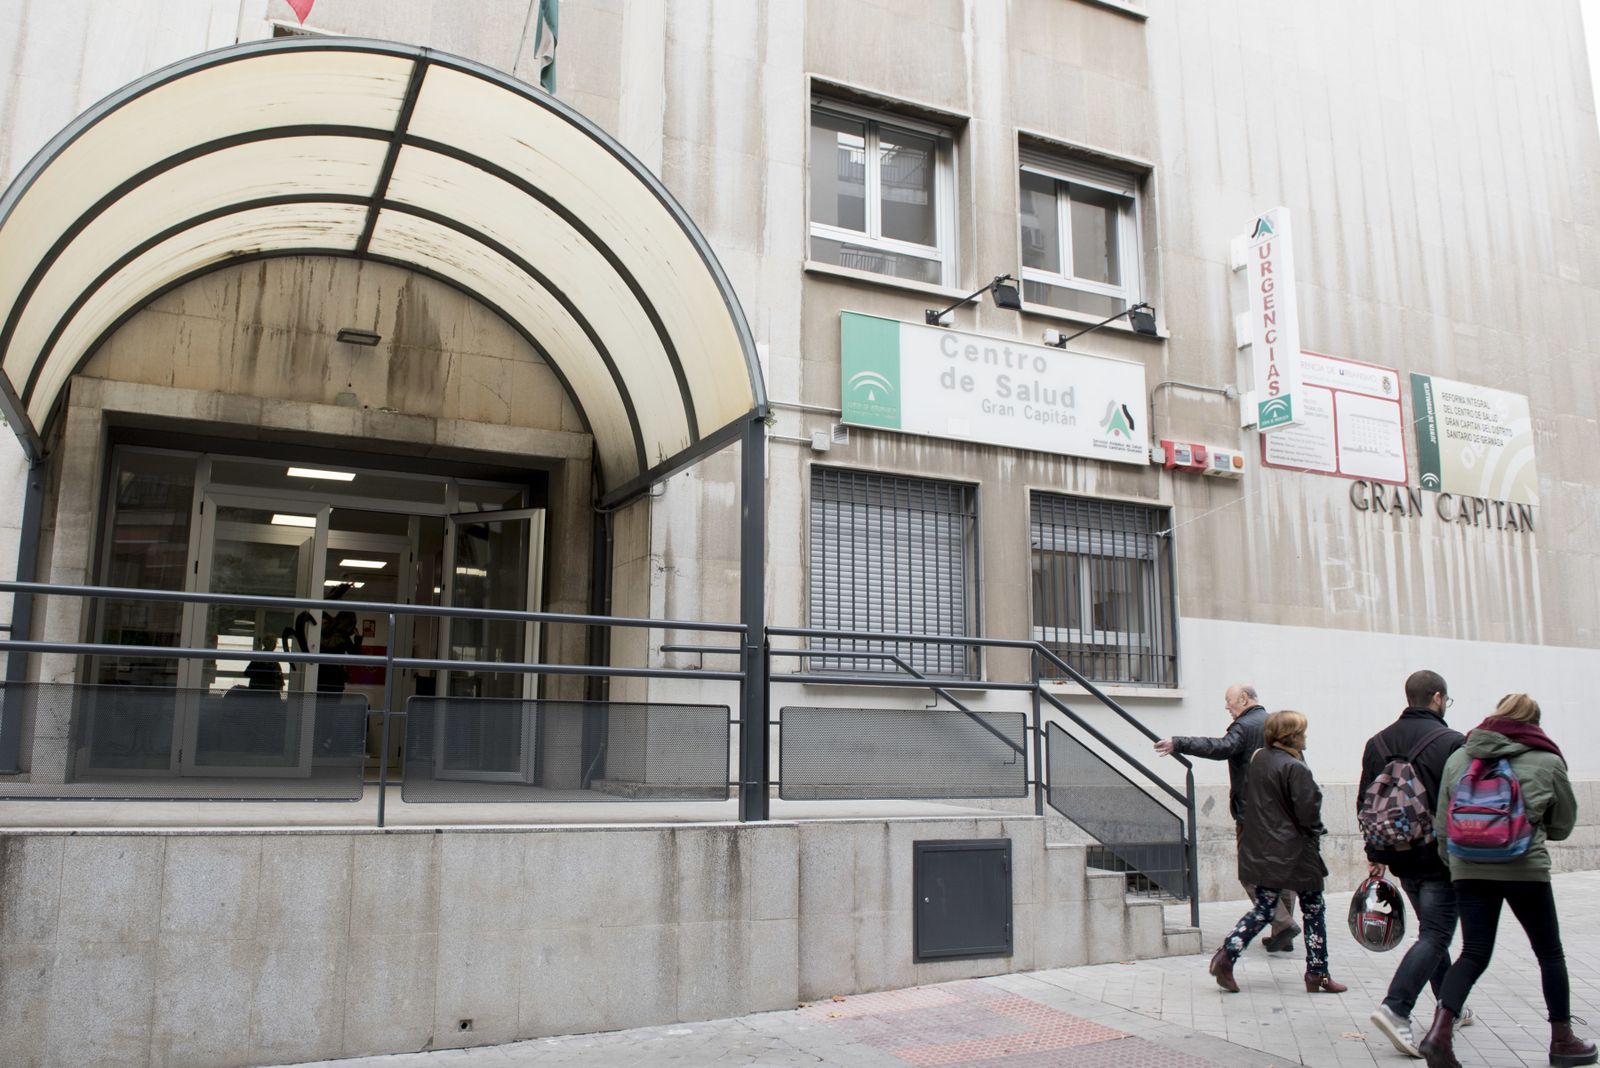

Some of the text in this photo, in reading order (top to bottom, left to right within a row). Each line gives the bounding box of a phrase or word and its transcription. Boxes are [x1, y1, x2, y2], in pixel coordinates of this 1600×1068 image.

[1258, 242, 1280, 397] URGENCIAS
[940, 333, 1047, 374] Centro
[940, 366, 1075, 409] de Salud
[1441, 392, 1491, 410] REFORMA INTEGRAL
[981, 398, 1076, 426] Gran Capitán
[1443, 404, 1498, 423] DEL CENTRO DE SALUD
[1445, 416, 1460, 426] GRAN
[1481, 423, 1491, 433] DEL
[1446, 429, 1504, 447] SANITARIO DE GRANADA
[1349, 479, 1535, 533] GRAN CAPITAN
